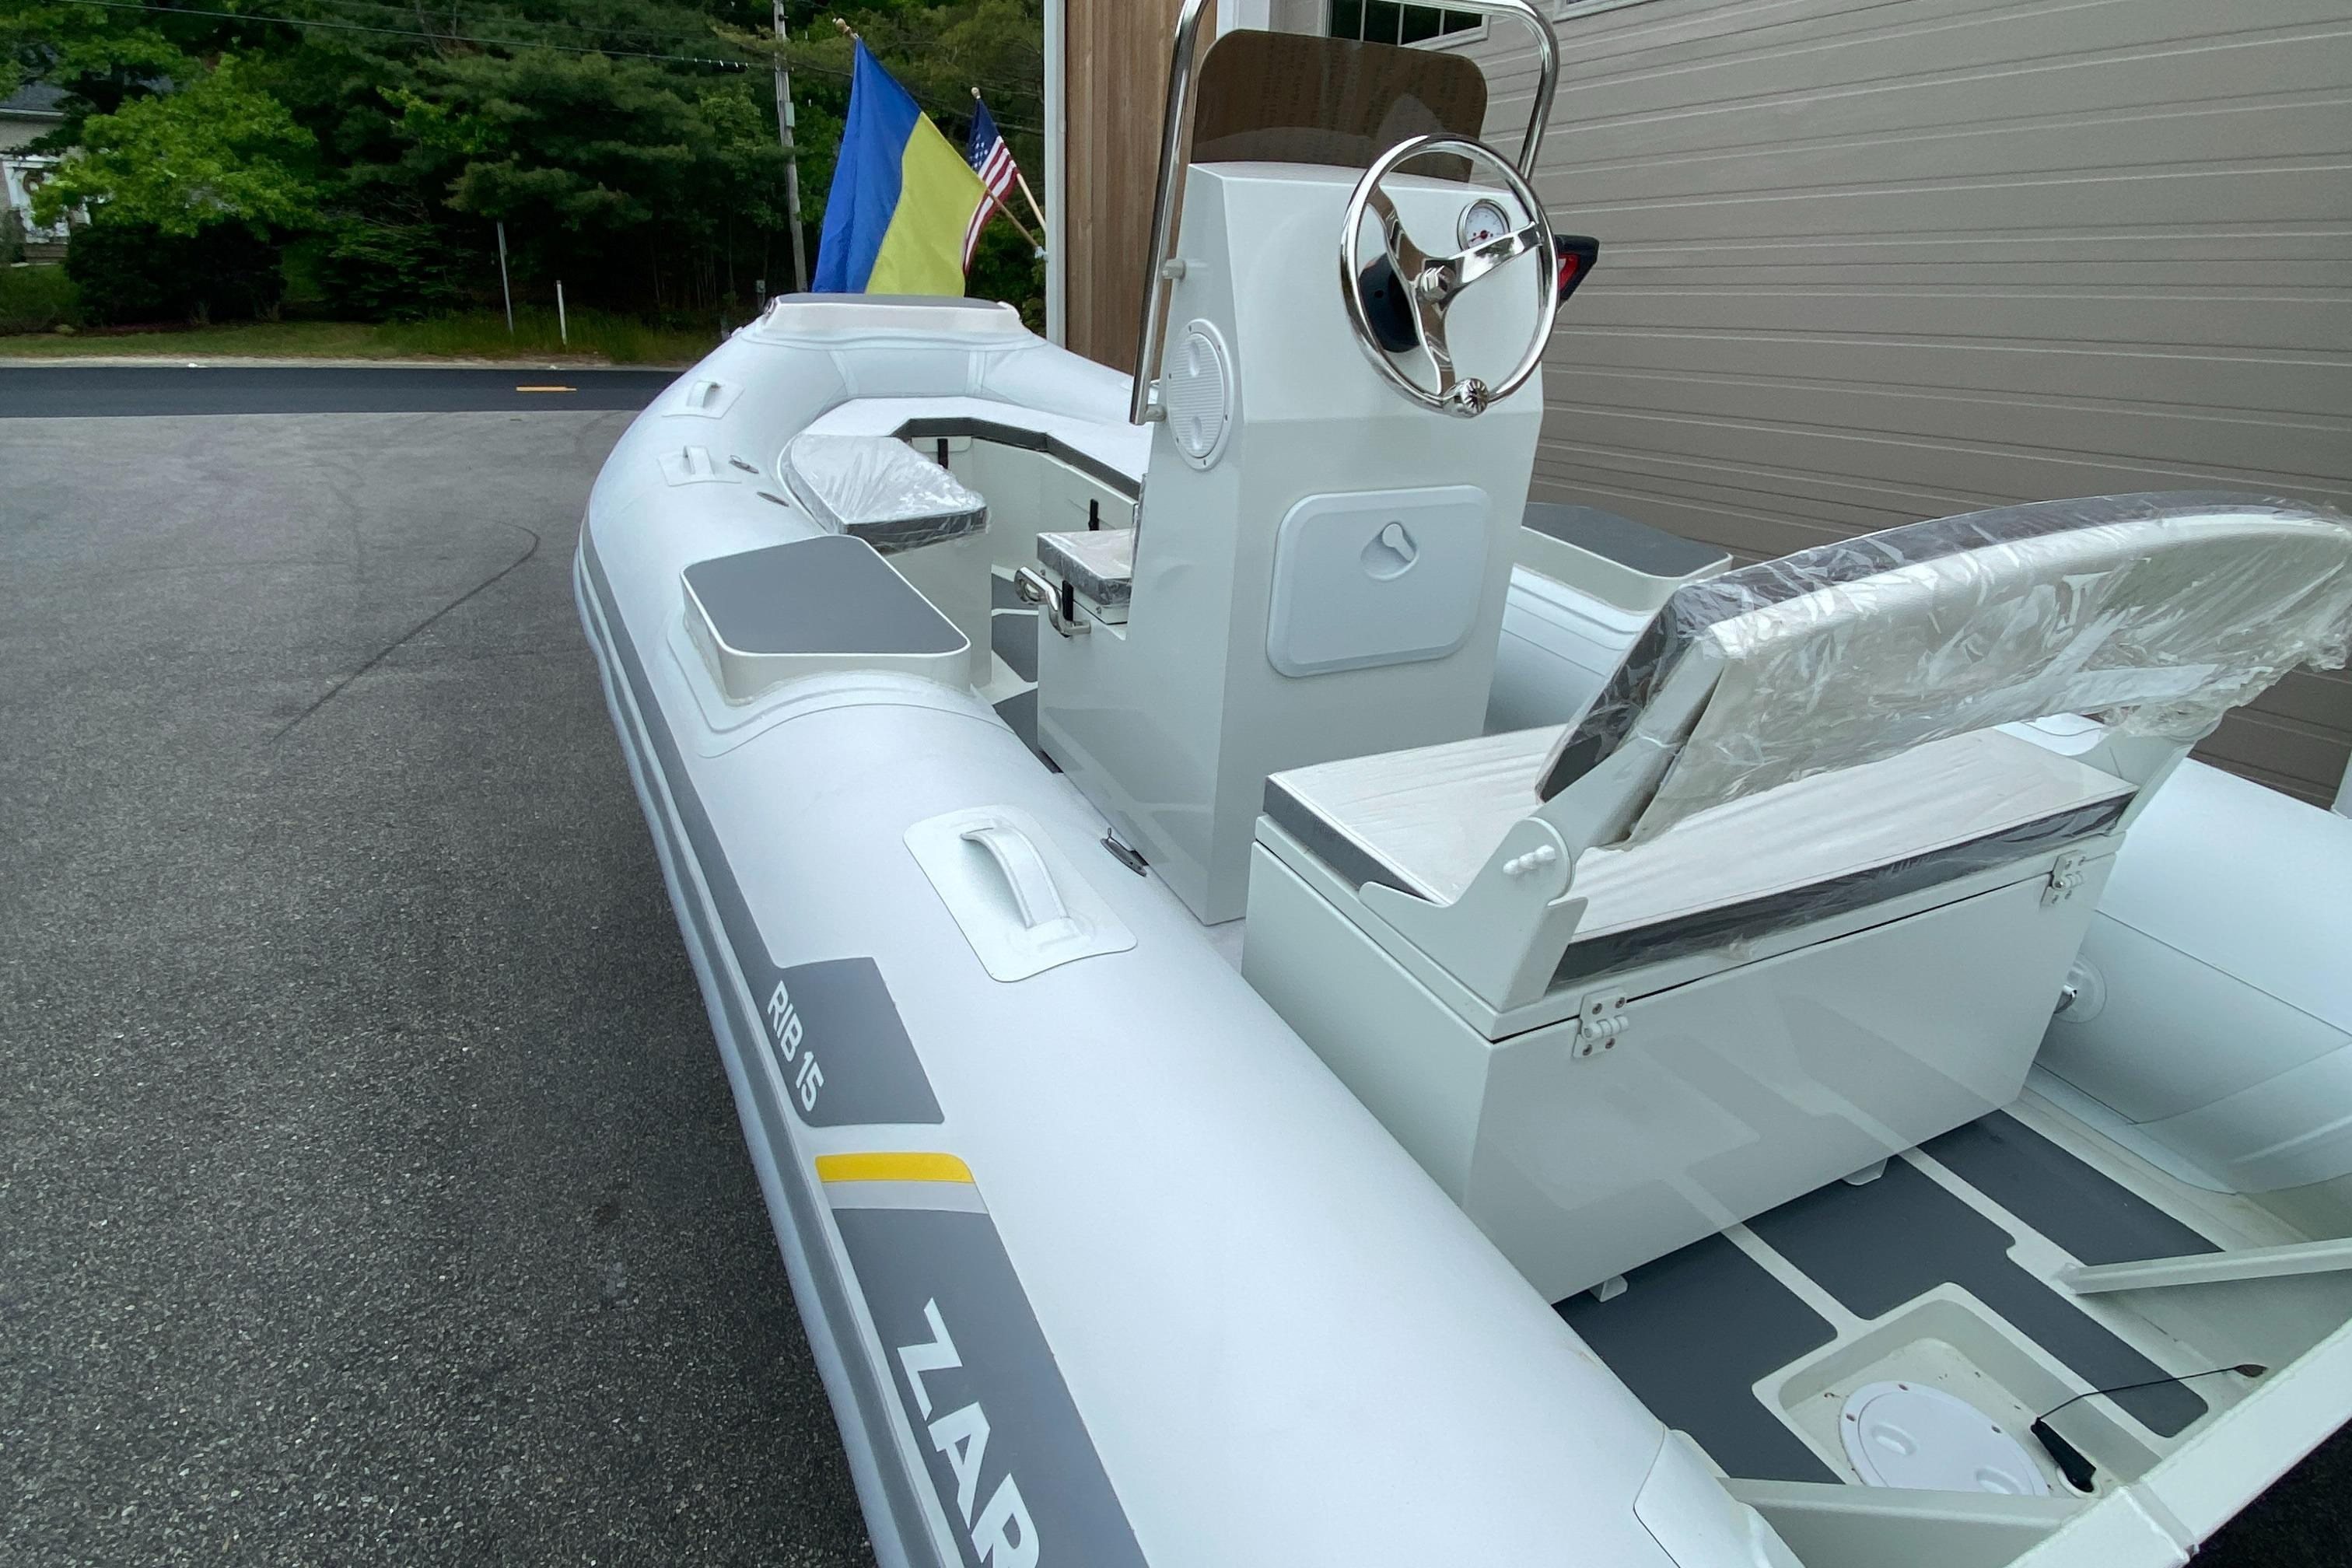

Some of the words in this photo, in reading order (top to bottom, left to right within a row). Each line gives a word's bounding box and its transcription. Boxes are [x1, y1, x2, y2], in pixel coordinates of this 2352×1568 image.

[768, 980, 803, 1062] RIB
[796, 1052, 824, 1111] 15
[898, 1297, 1040, 1568] ZAR
